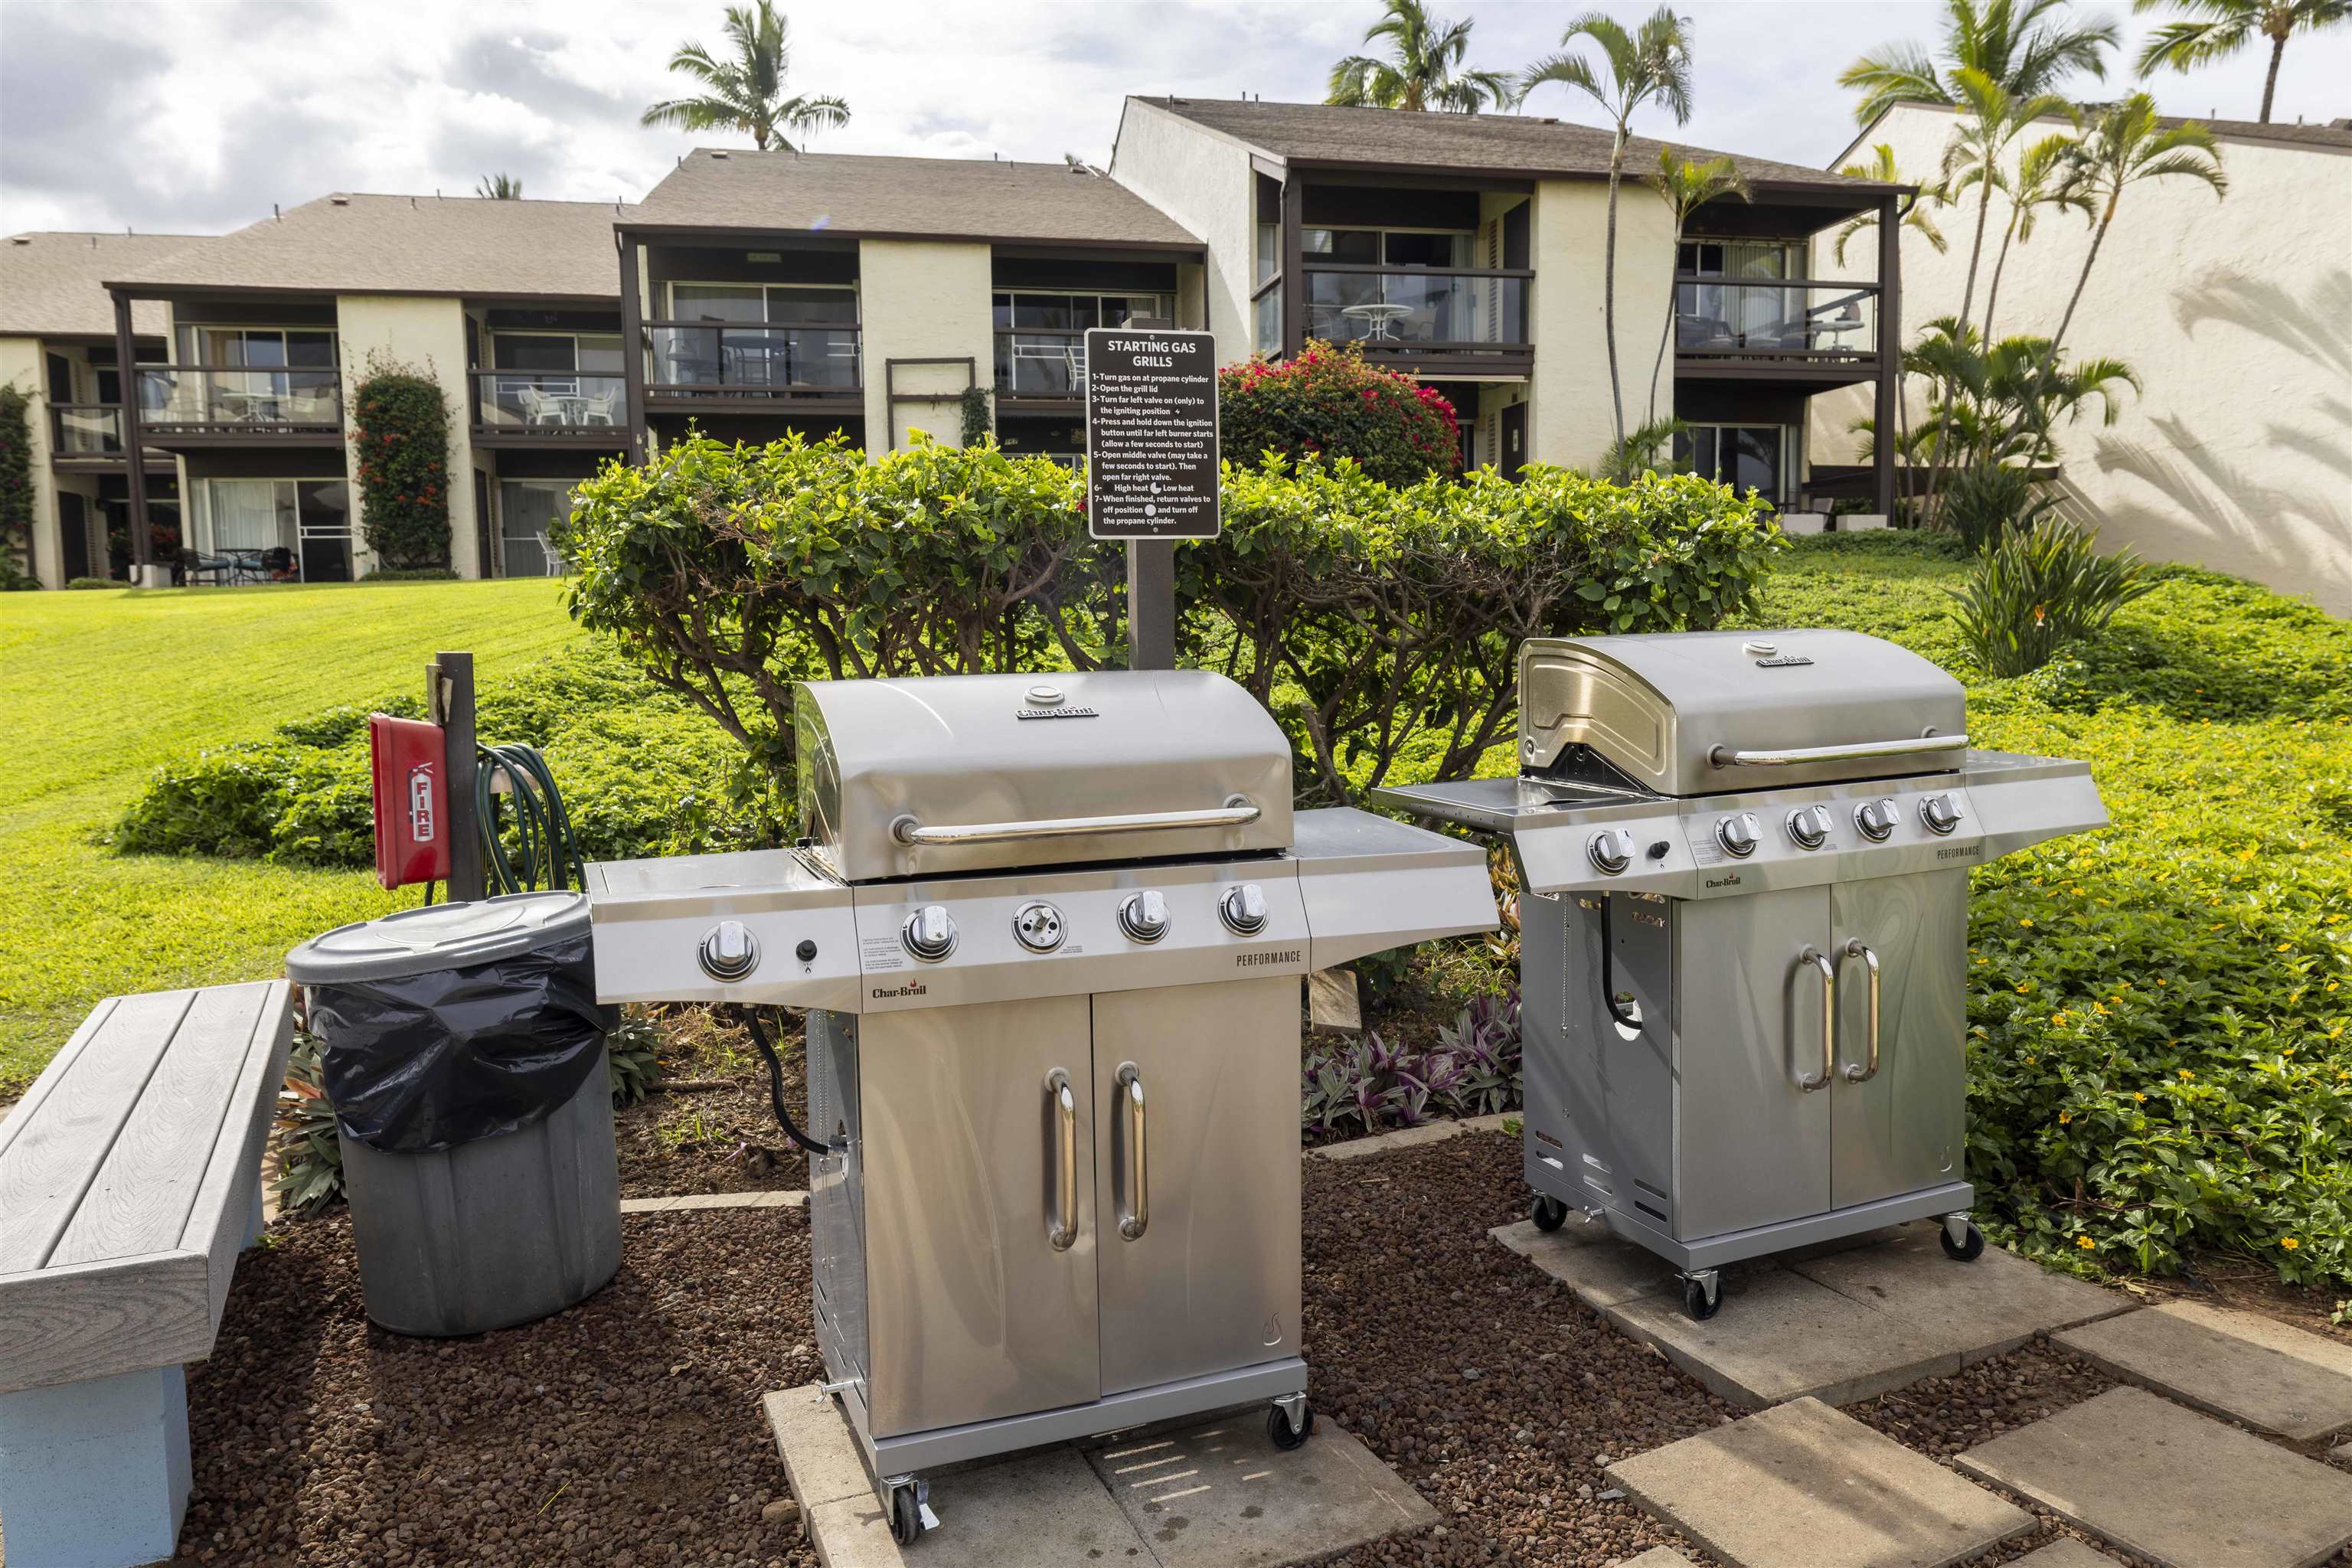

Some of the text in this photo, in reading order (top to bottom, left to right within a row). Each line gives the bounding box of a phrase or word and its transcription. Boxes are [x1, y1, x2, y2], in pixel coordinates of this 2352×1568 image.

[1108, 340, 1196, 353] STARTING GAS
[1133, 356, 1172, 368] GRILLS
[1181, 375, 1209, 384] cylinder
[1133, 385, 1148, 394] grill
[1174, 397, 1195, 406] (only)
[1113, 407, 1141, 416] igniting
[1142, 407, 1171, 416] position
[1187, 419, 1213, 428] ignition
[1101, 439, 1124, 448] (allow
[1168, 452, 1186, 460] (may
[1132, 473, 1150, 482] right
[1115, 484, 1132, 493] High
[1125, 495, 1155, 503] finished,
[1115, 506, 1143, 514] position
[1146, 517, 1177, 525] cylinder.
[416, 782, 430, 836] FIRE
[1937, 845, 1979, 859] PERFORMANCE
[1706, 877, 1740, 888] Char-Broil
[1236, 950, 1302, 967] PERFORMANCE
[872, 985, 926, 998] Char-Broil
